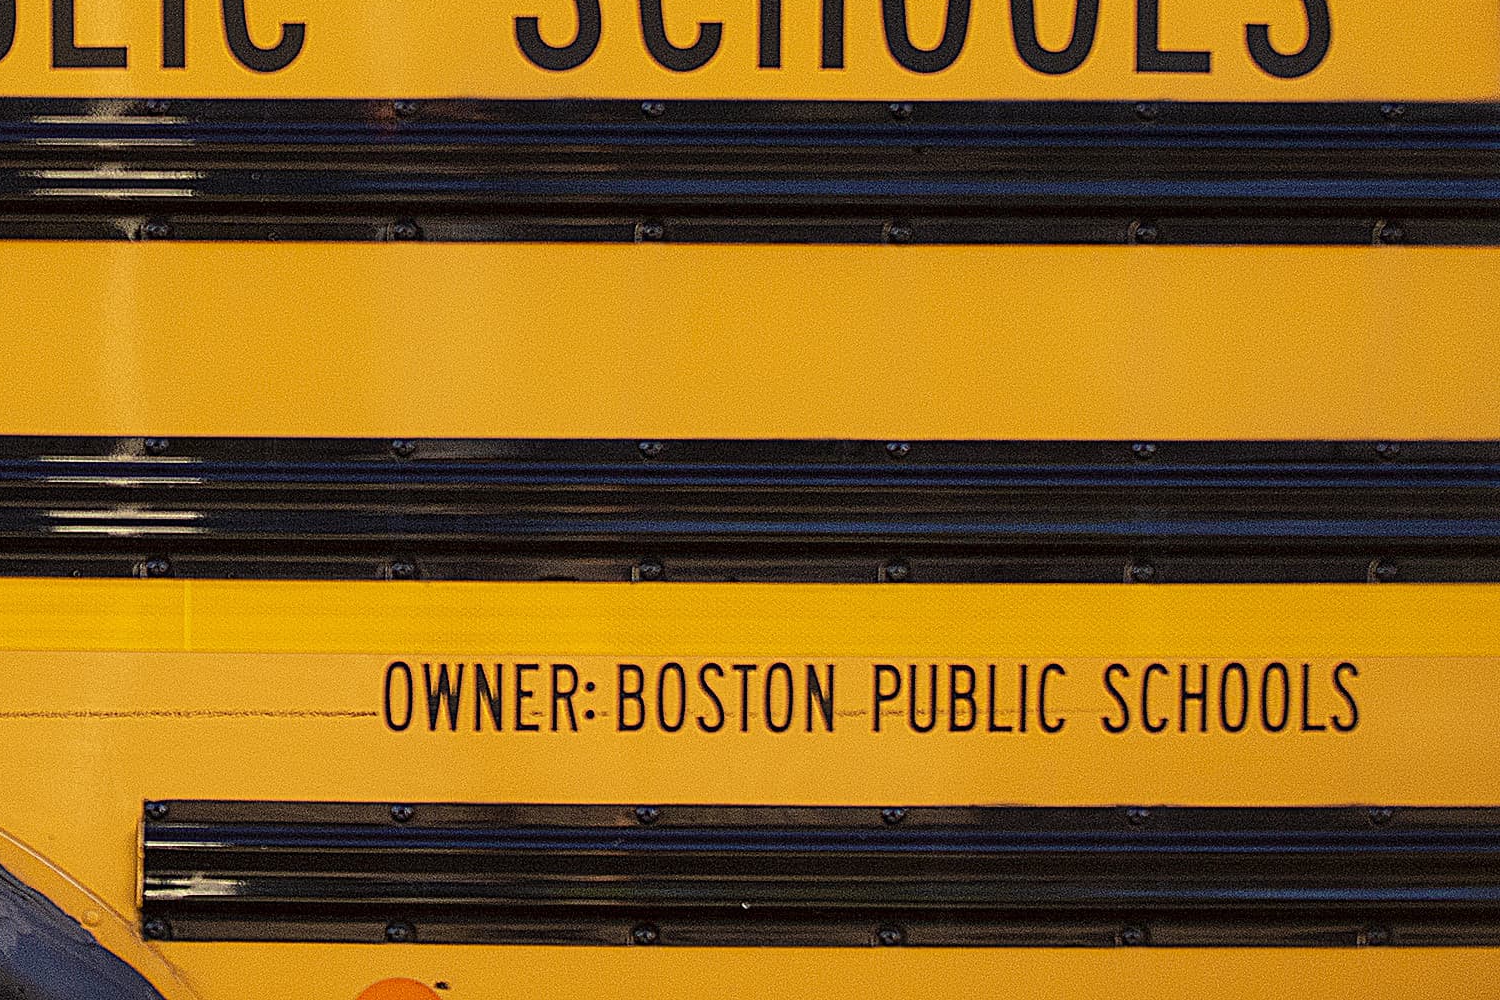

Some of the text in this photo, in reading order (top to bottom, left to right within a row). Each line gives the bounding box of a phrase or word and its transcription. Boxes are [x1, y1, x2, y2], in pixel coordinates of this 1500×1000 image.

[384, 661, 1359, 734] OWNER: BOSTON PUBLIC SCHOOLS
